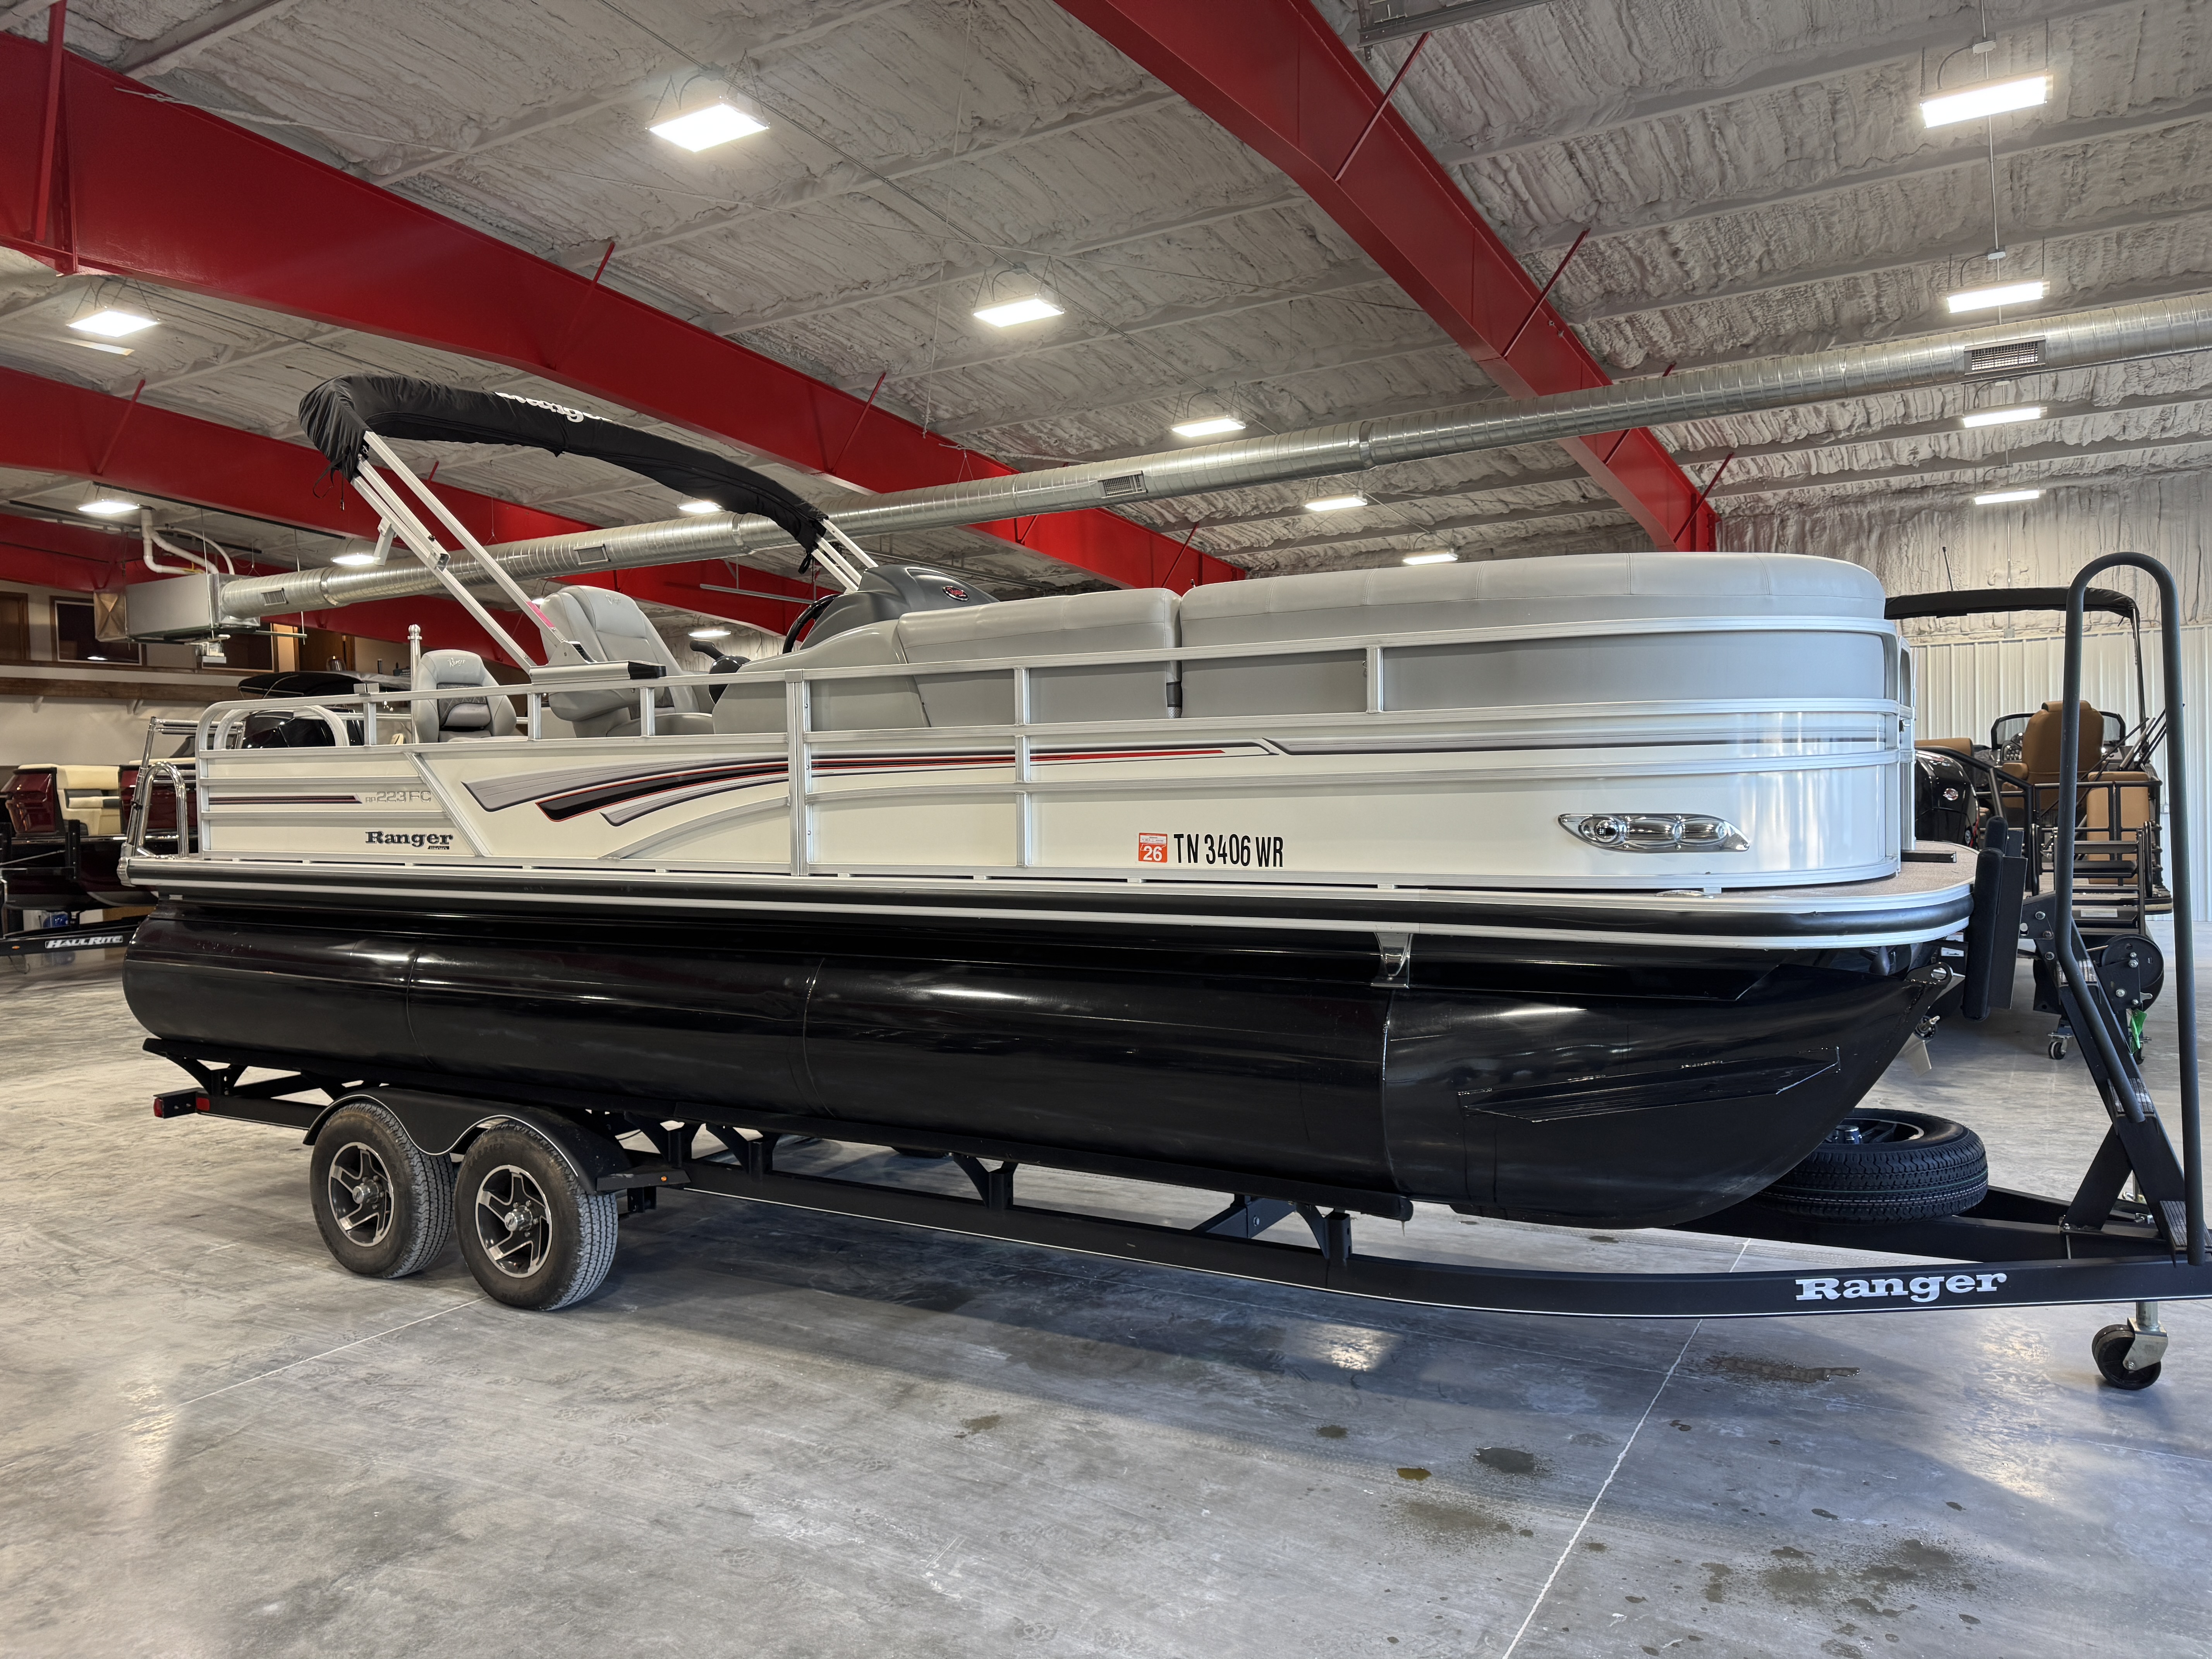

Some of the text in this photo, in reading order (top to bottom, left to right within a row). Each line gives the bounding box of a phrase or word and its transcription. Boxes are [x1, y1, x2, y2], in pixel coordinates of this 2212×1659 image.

[365, 831, 453, 847] Ranger
[1143, 845, 1163, 861] 26
[1173, 834, 1283, 867] TN 3406 WR
[1795, 1273, 2007, 1302] Ranger
